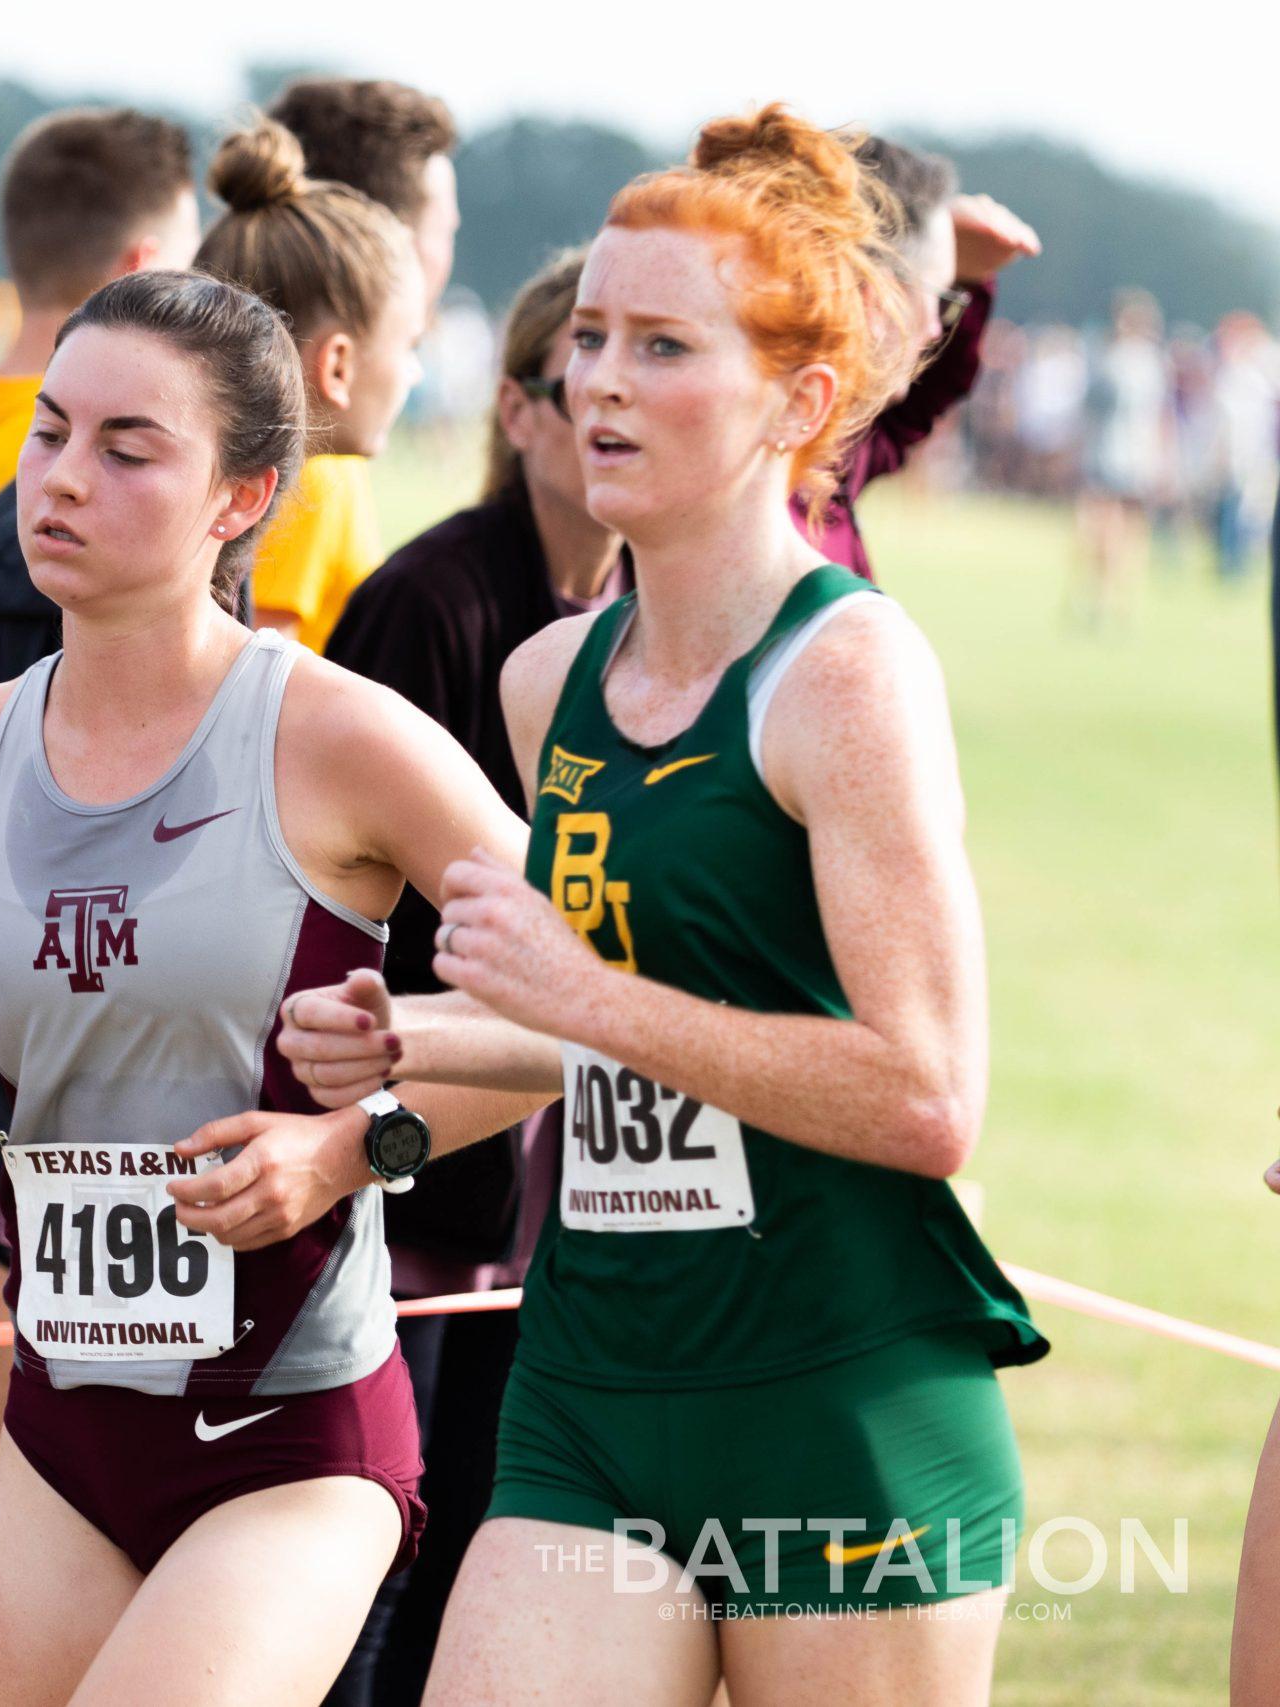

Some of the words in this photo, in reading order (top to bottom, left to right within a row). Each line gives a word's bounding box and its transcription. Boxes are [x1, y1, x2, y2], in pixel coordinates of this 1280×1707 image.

[572, 1064, 716, 1164] 4032
[25, 1151, 112, 1176] TEXAS
[120, 1151, 197, 1176] A&M
[569, 1188, 721, 1214] INVITATIONAL
[36, 1202, 209, 1298] 4196
[36, 1319, 204, 1344] INVITATIONAL
